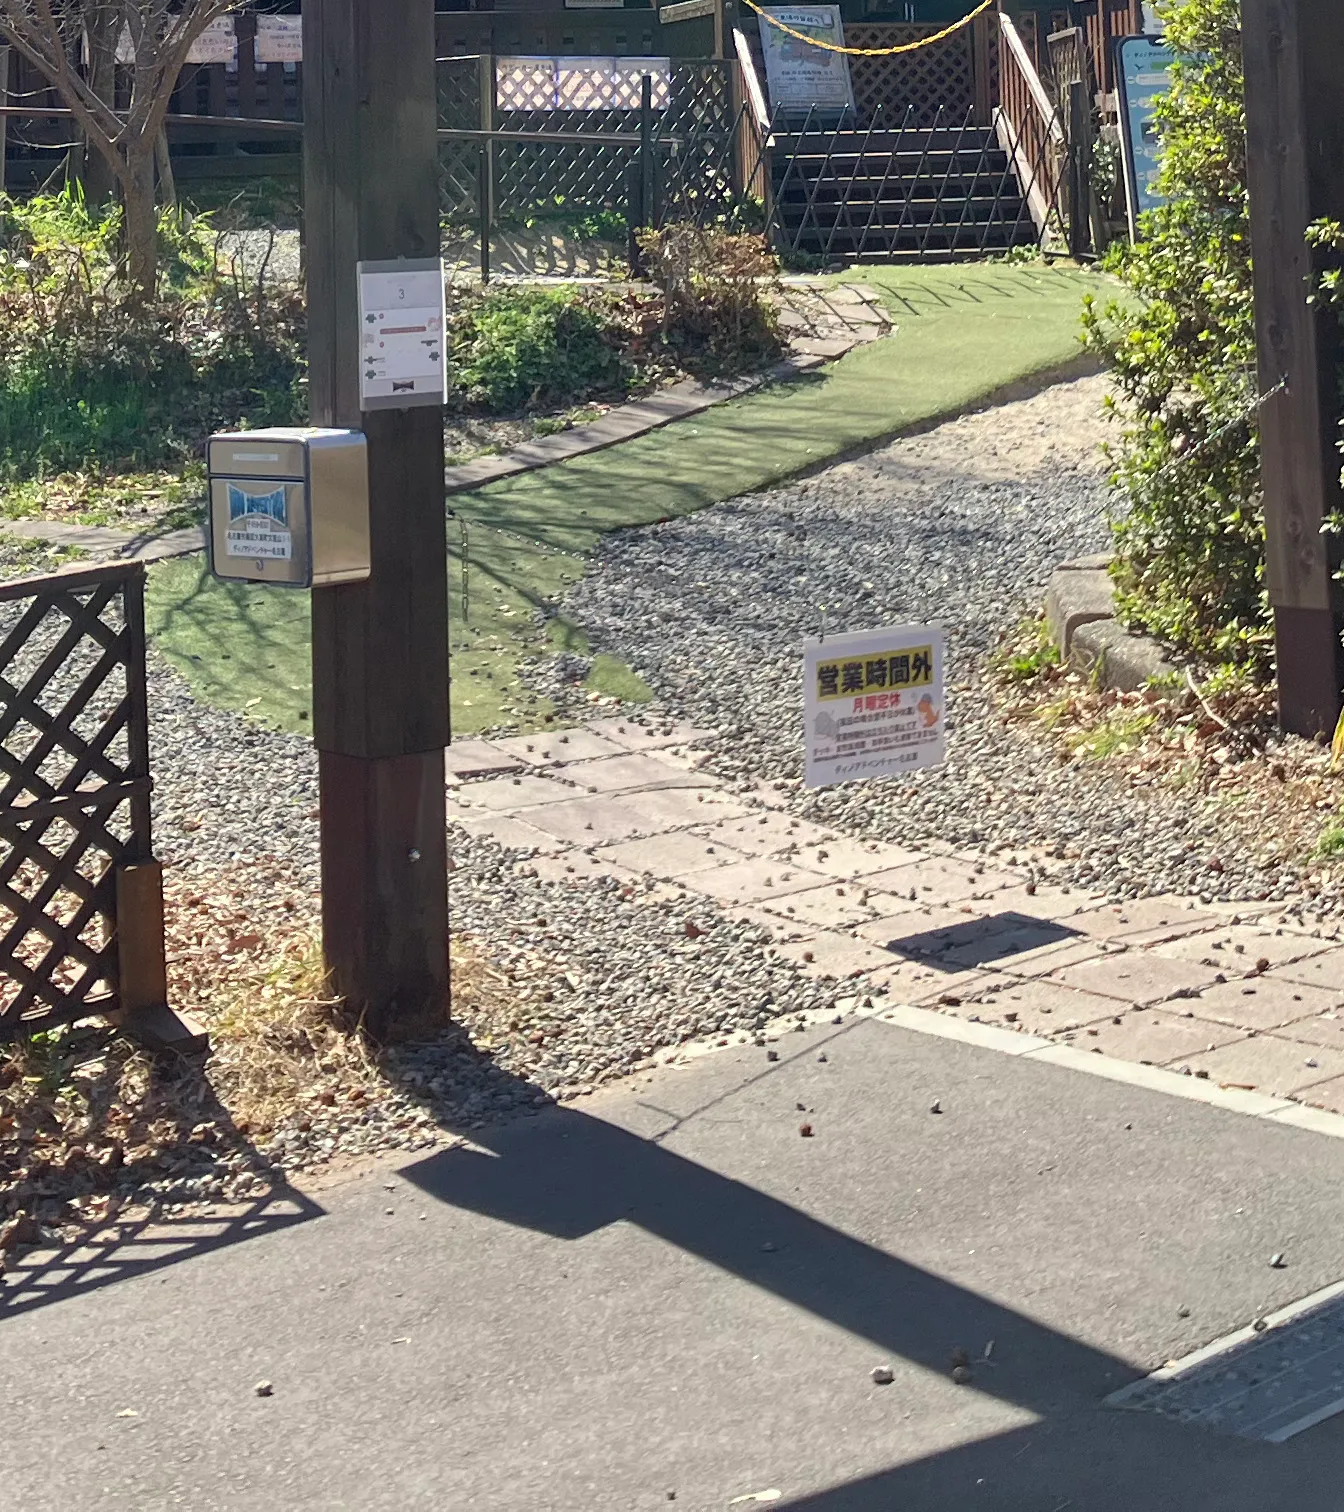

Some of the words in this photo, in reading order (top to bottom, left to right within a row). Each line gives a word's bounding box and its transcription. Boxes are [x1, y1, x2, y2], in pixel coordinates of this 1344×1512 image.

[818, 651, 932, 697] 営業時間外
[852, 691, 901, 713] 月曜定休
